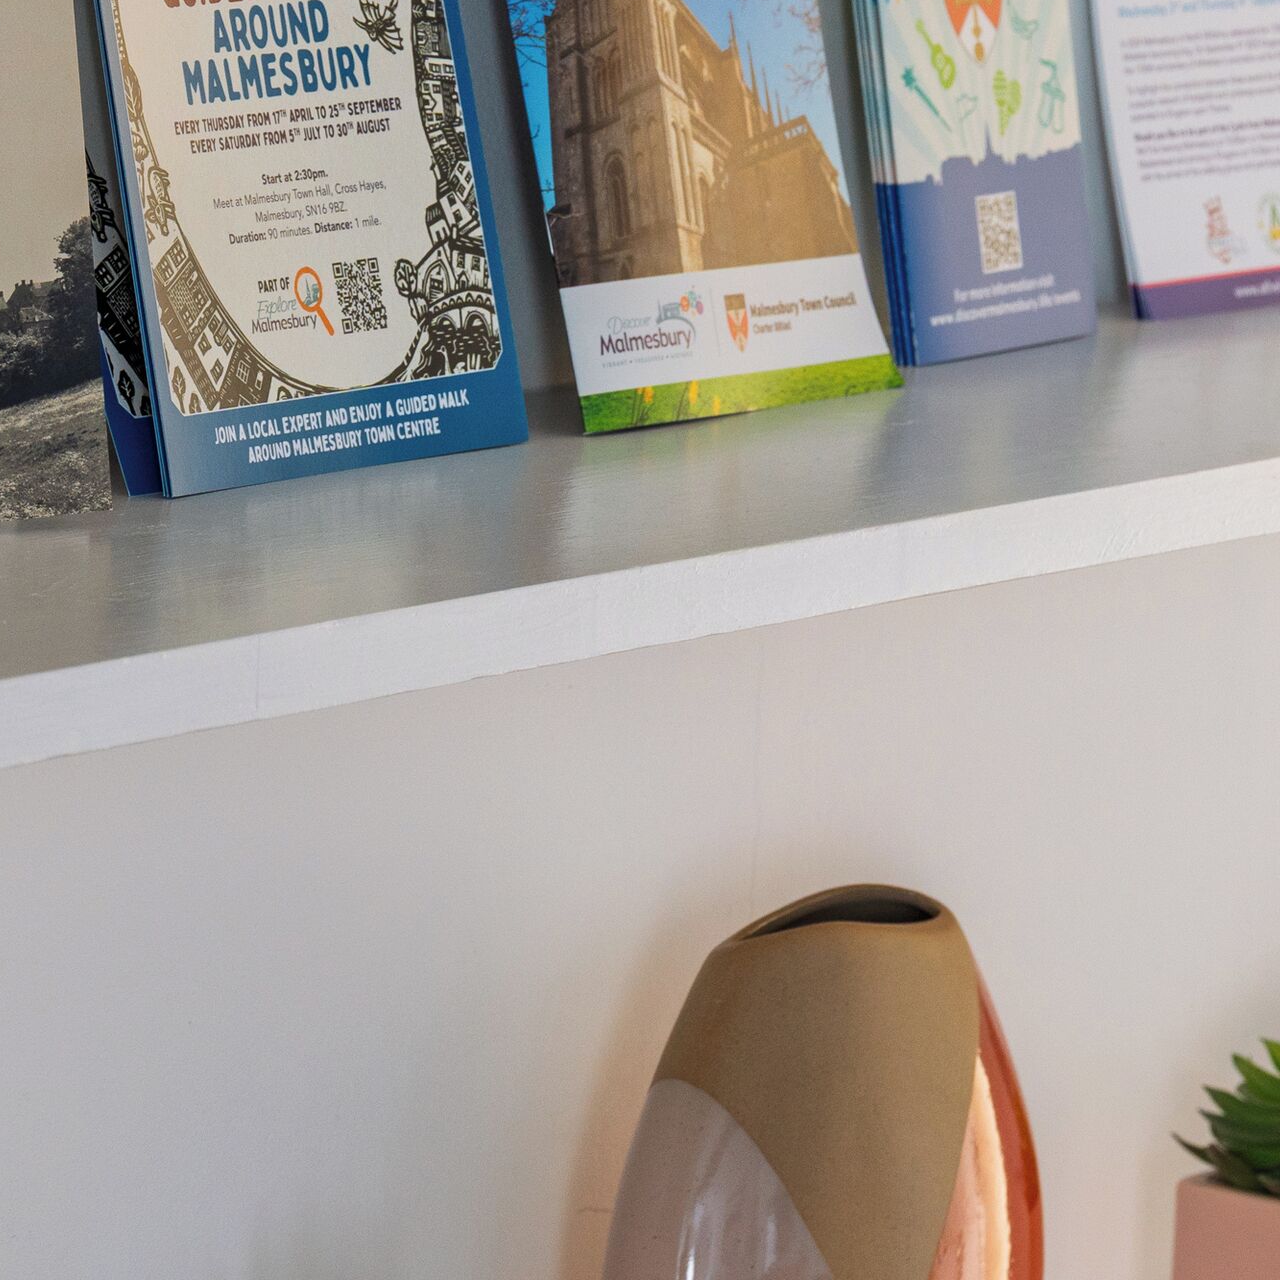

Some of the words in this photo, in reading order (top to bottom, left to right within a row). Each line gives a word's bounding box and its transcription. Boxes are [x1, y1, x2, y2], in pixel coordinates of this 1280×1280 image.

[181, 43, 371, 106] MALMESBURY
[174, 121, 200, 136] EVERY
[202, 115, 245, 132] THURSDAY
[246, 111, 271, 127] FROM
[289, 107, 315, 122] APRIL
[315, 105, 327, 121] TO
[347, 96, 402, 116] SEPTEMBER
[190, 138, 217, 154] EVERY
[219, 133, 261, 151] SATURDAY
[263, 130, 288, 146] FROM
[303, 126, 321, 142] JULY
[323, 123, 335, 139] TO
[356, 117, 391, 136] AUGUST
[261, 173, 282, 186] Start
[284, 172, 293, 182] at
[294, 168, 328, 182] 2:30pm.
[212, 198, 234, 209] Meet
[235, 196, 244, 207] at
[244, 191, 292, 206] Malmesbury
[292, 188, 314, 200] Town
[314, 184, 333, 197] Hall,
[334, 182, 358, 195] Cross
[358, 179, 387, 194] Hayes,
[255, 207, 305, 223] Malmesbury,
[305, 203, 328, 217] SN16
[228, 230, 267, 245] Duration:
[267, 228, 278, 240] 90
[279, 225, 313, 239] minutes.
[314, 219, 353, 234] Distance:
[354, 217, 361, 228] 1
[361, 214, 382, 227] mile.
[257, 277, 278, 294] PART
[279, 276, 291, 291] OF
[256, 296, 298, 321] Explore
[799, 297, 822, 312] Town
[823, 291, 857, 309] Council
[251, 313, 317, 334] Malmesbury
[600, 322, 694, 356] Malmesbury
[214, 425, 237, 445] JOIN
[238, 423, 247, 440] A
[247, 418, 282, 440] LOCAL
[283, 411, 324, 434] EXPERT
[325, 407, 348, 428] AND
[350, 402, 383, 424] ENJOY
[385, 400, 394, 418] A
[395, 394, 437, 416] GUIDED
[438, 388, 470, 408] WALK
[248, 442, 291, 464] AROUND
[293, 431, 363, 457] MALMESBURY
[364, 425, 396, 445] TOWN
[396, 417, 441, 440] CENTRE
